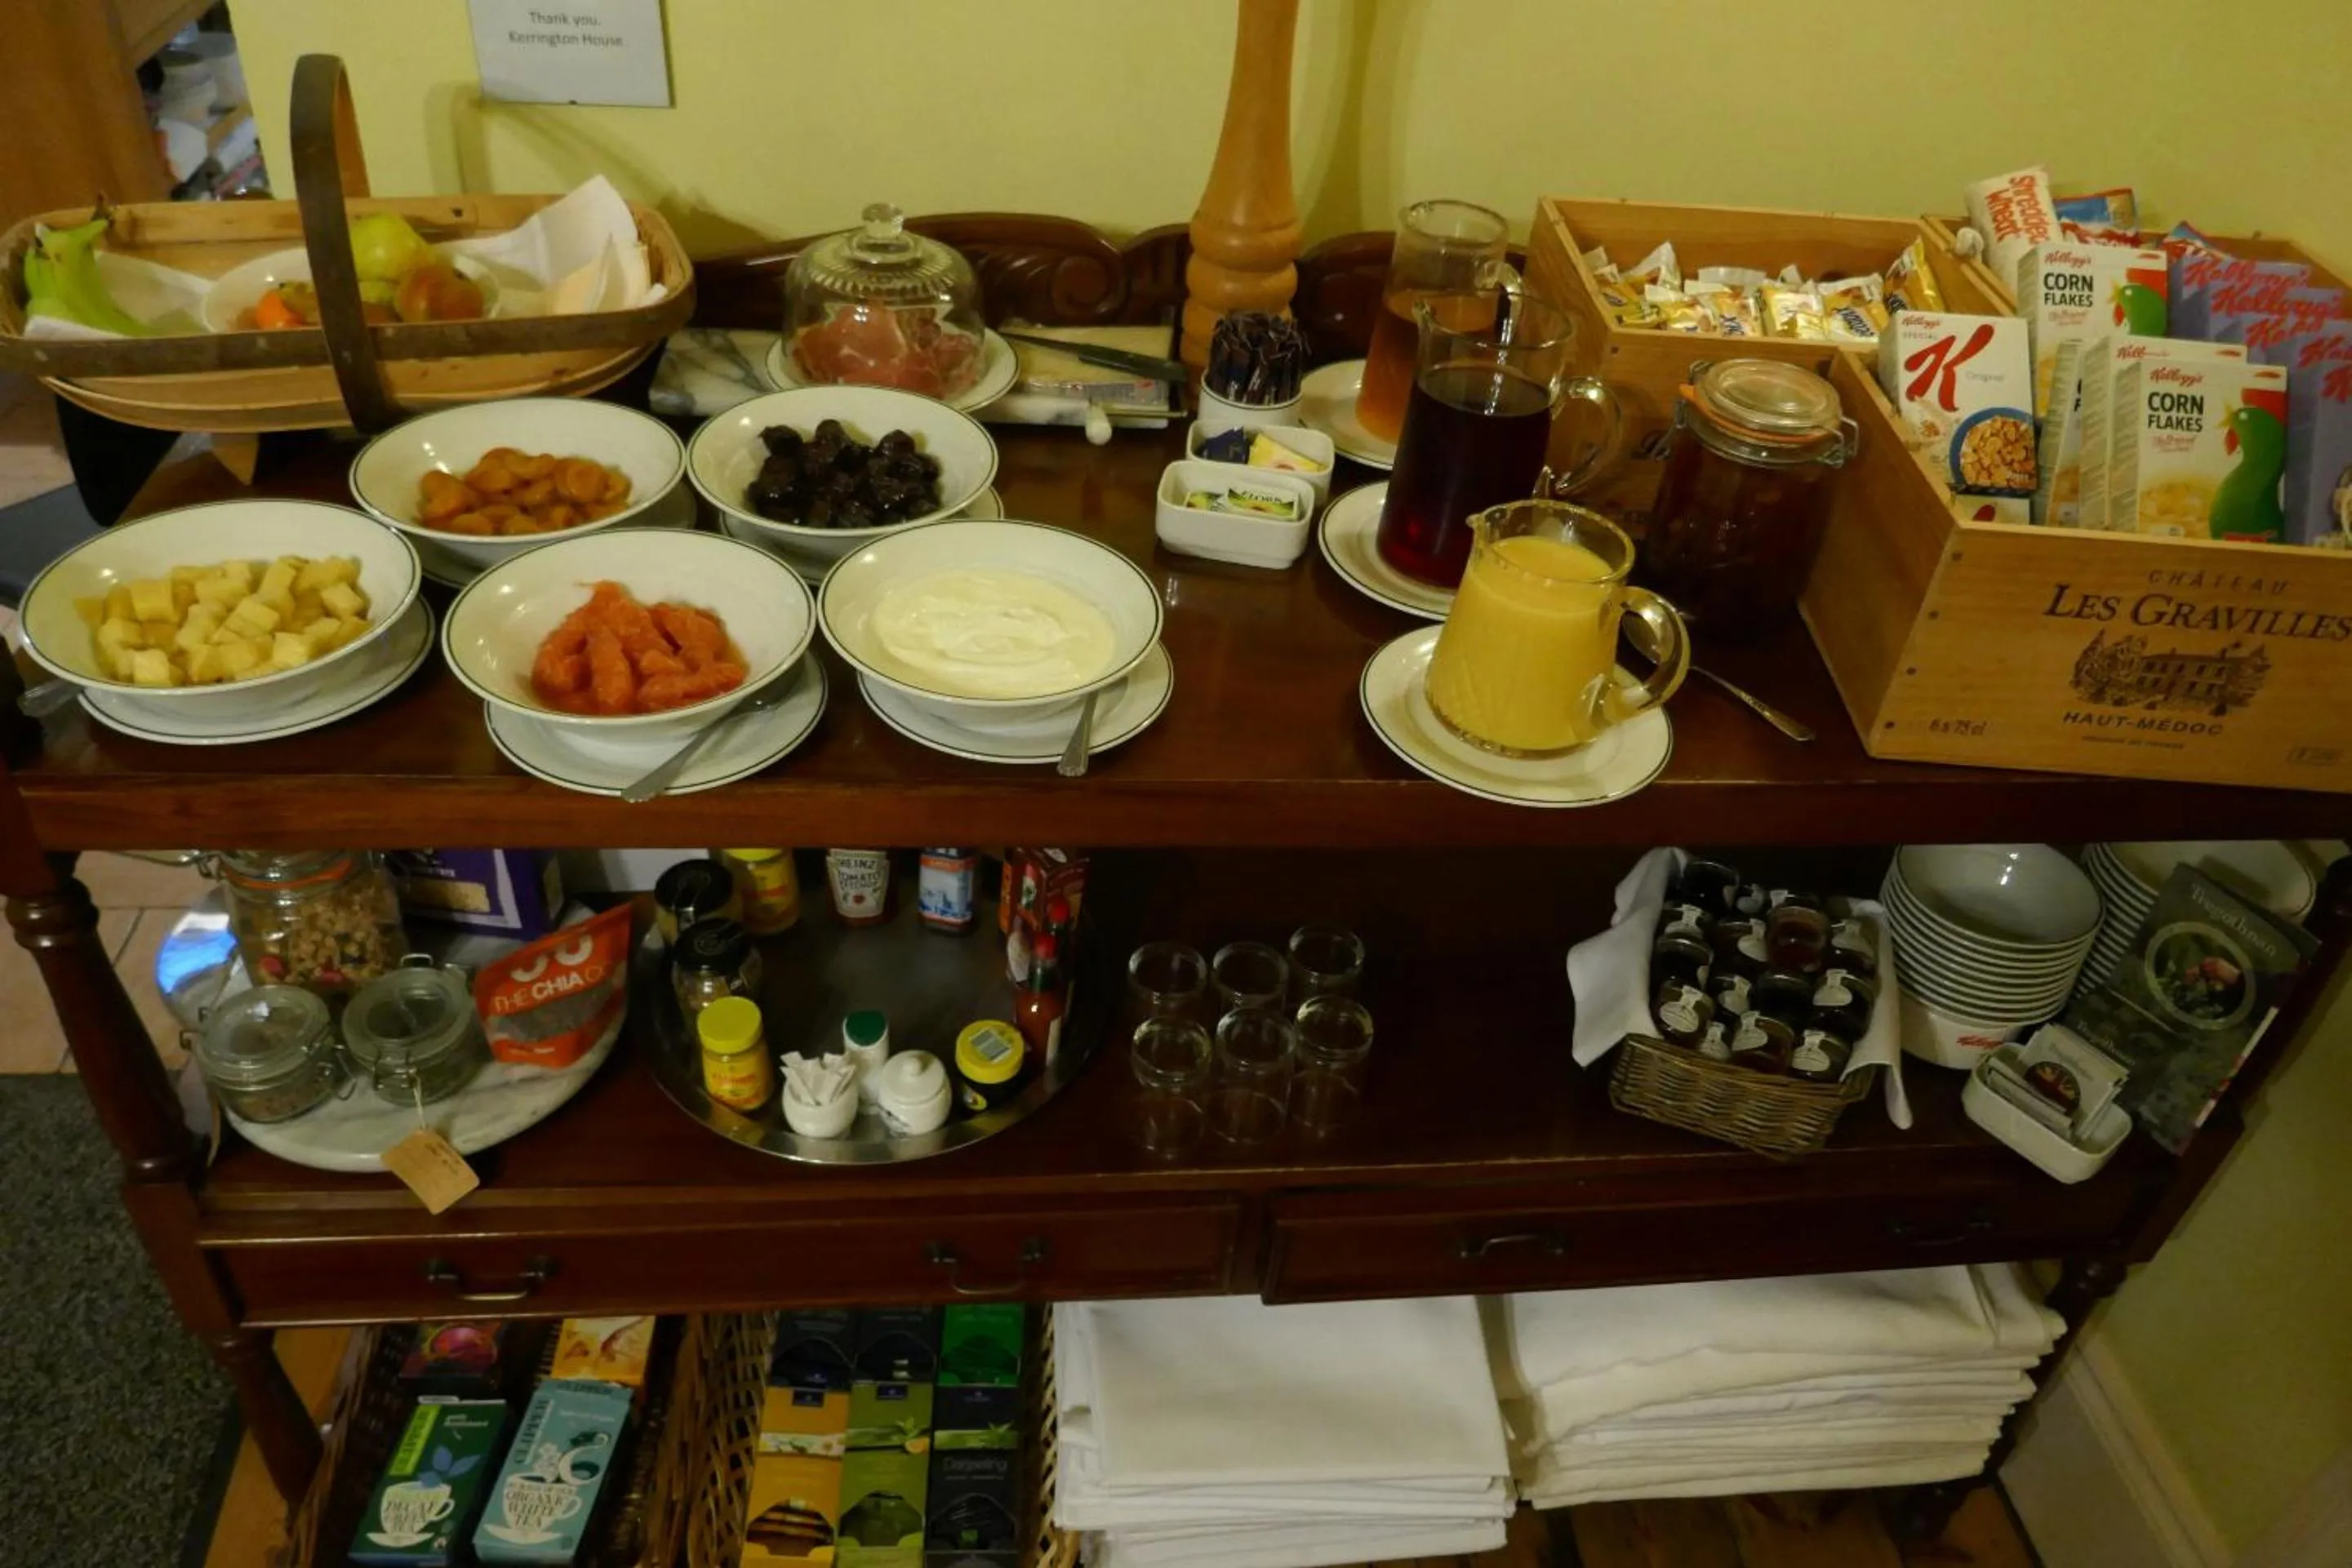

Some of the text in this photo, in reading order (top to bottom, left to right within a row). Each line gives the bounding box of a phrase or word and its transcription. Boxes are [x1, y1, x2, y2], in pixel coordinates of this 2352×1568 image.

[528, 12, 570, 25] Thank
[509, 31, 623, 47] Kerrington House
[2044, 251, 2092, 269] Kellogg's
[2043, 272, 2093, 291] CORN
[2044, 292, 2093, 308] FLAKES
[1904, 323, 1994, 412] K
[2150, 366, 2203, 388] Kellogg's
[2148, 392, 2203, 415] CORN
[2148, 414, 2203, 433] FLAKES
[531, 971, 585, 1000] CHIA
